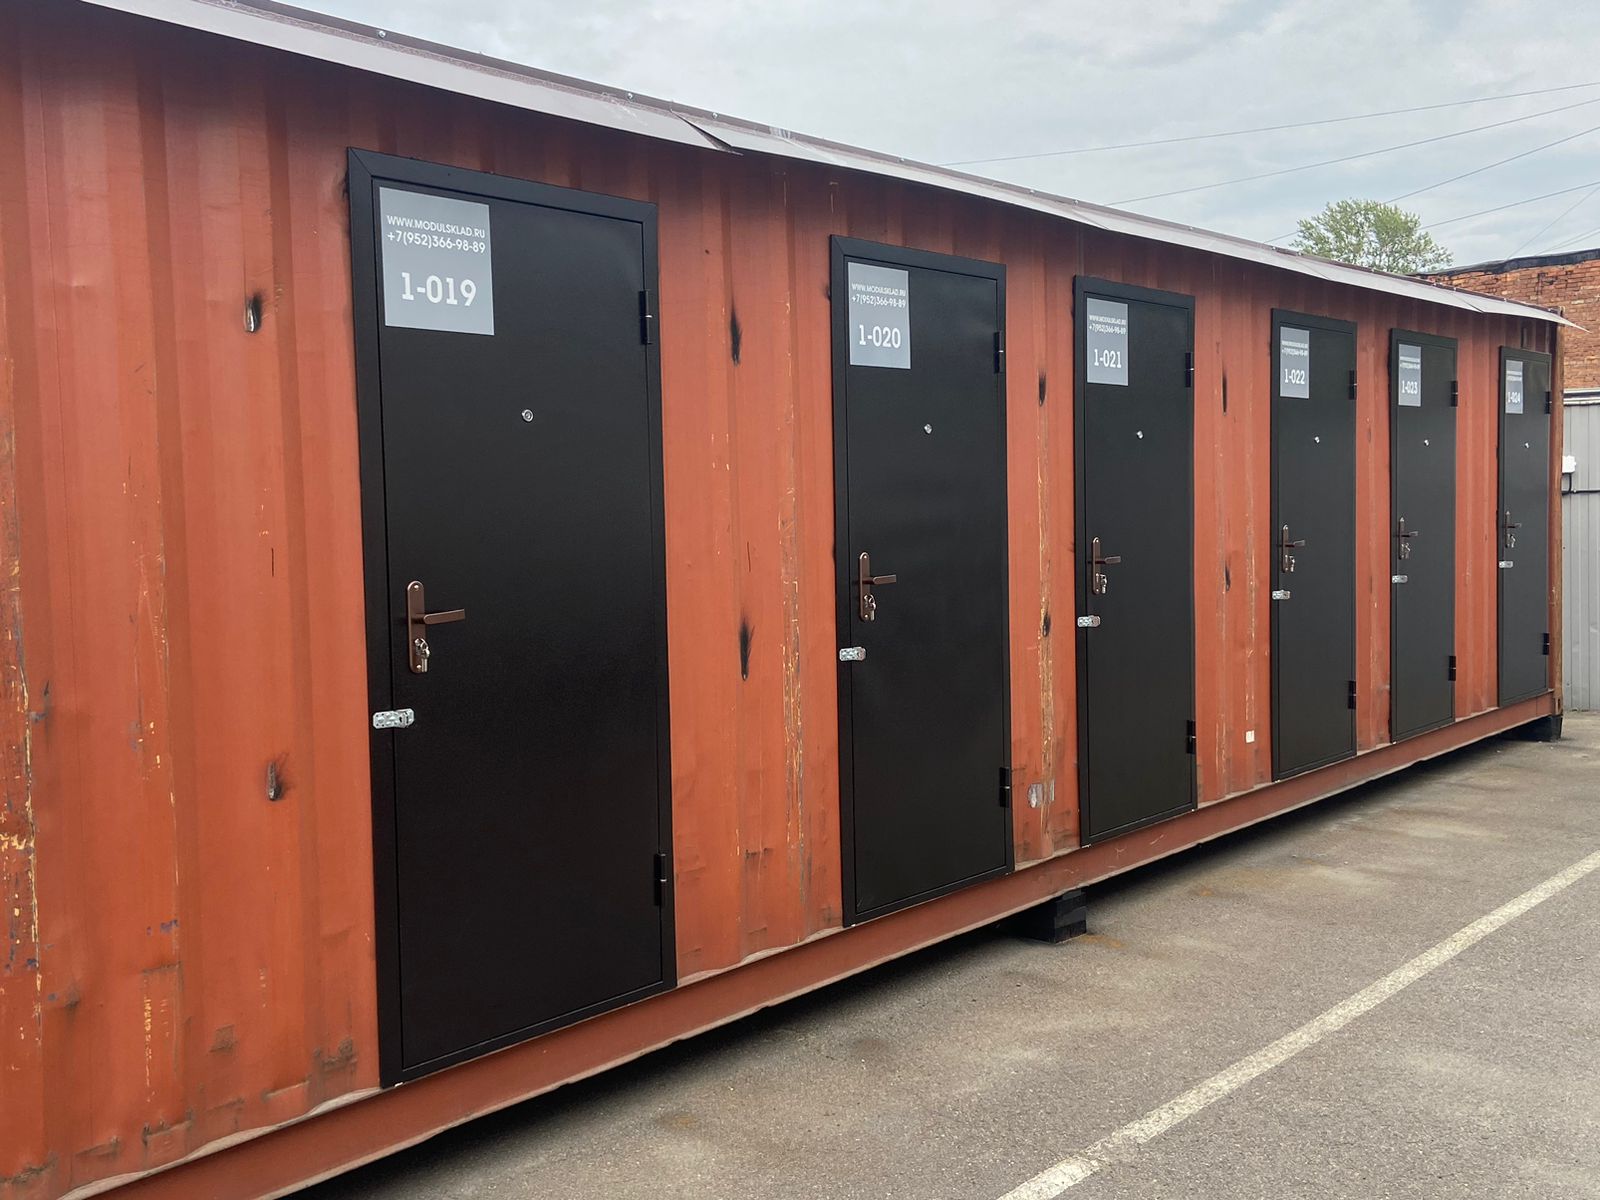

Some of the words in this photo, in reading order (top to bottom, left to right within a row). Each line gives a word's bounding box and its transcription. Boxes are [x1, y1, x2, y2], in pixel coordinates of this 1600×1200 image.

[387, 215, 485, 238] WWW.MODULSKLAD.RU
[388, 230, 486, 254] +7(952)366-98-89
[401, 272, 476, 306] 1-019
[851, 283, 906, 297] WWW.MODULSKLAD.RU
[851, 294, 906, 308] +7(952)366-98-89
[859, 324, 901, 349] 1-020
[1094, 348, 1122, 368] 1-021
[1284, 368, 1305, 385] 1-022
[1401, 380, 1418, 394] 1-023
